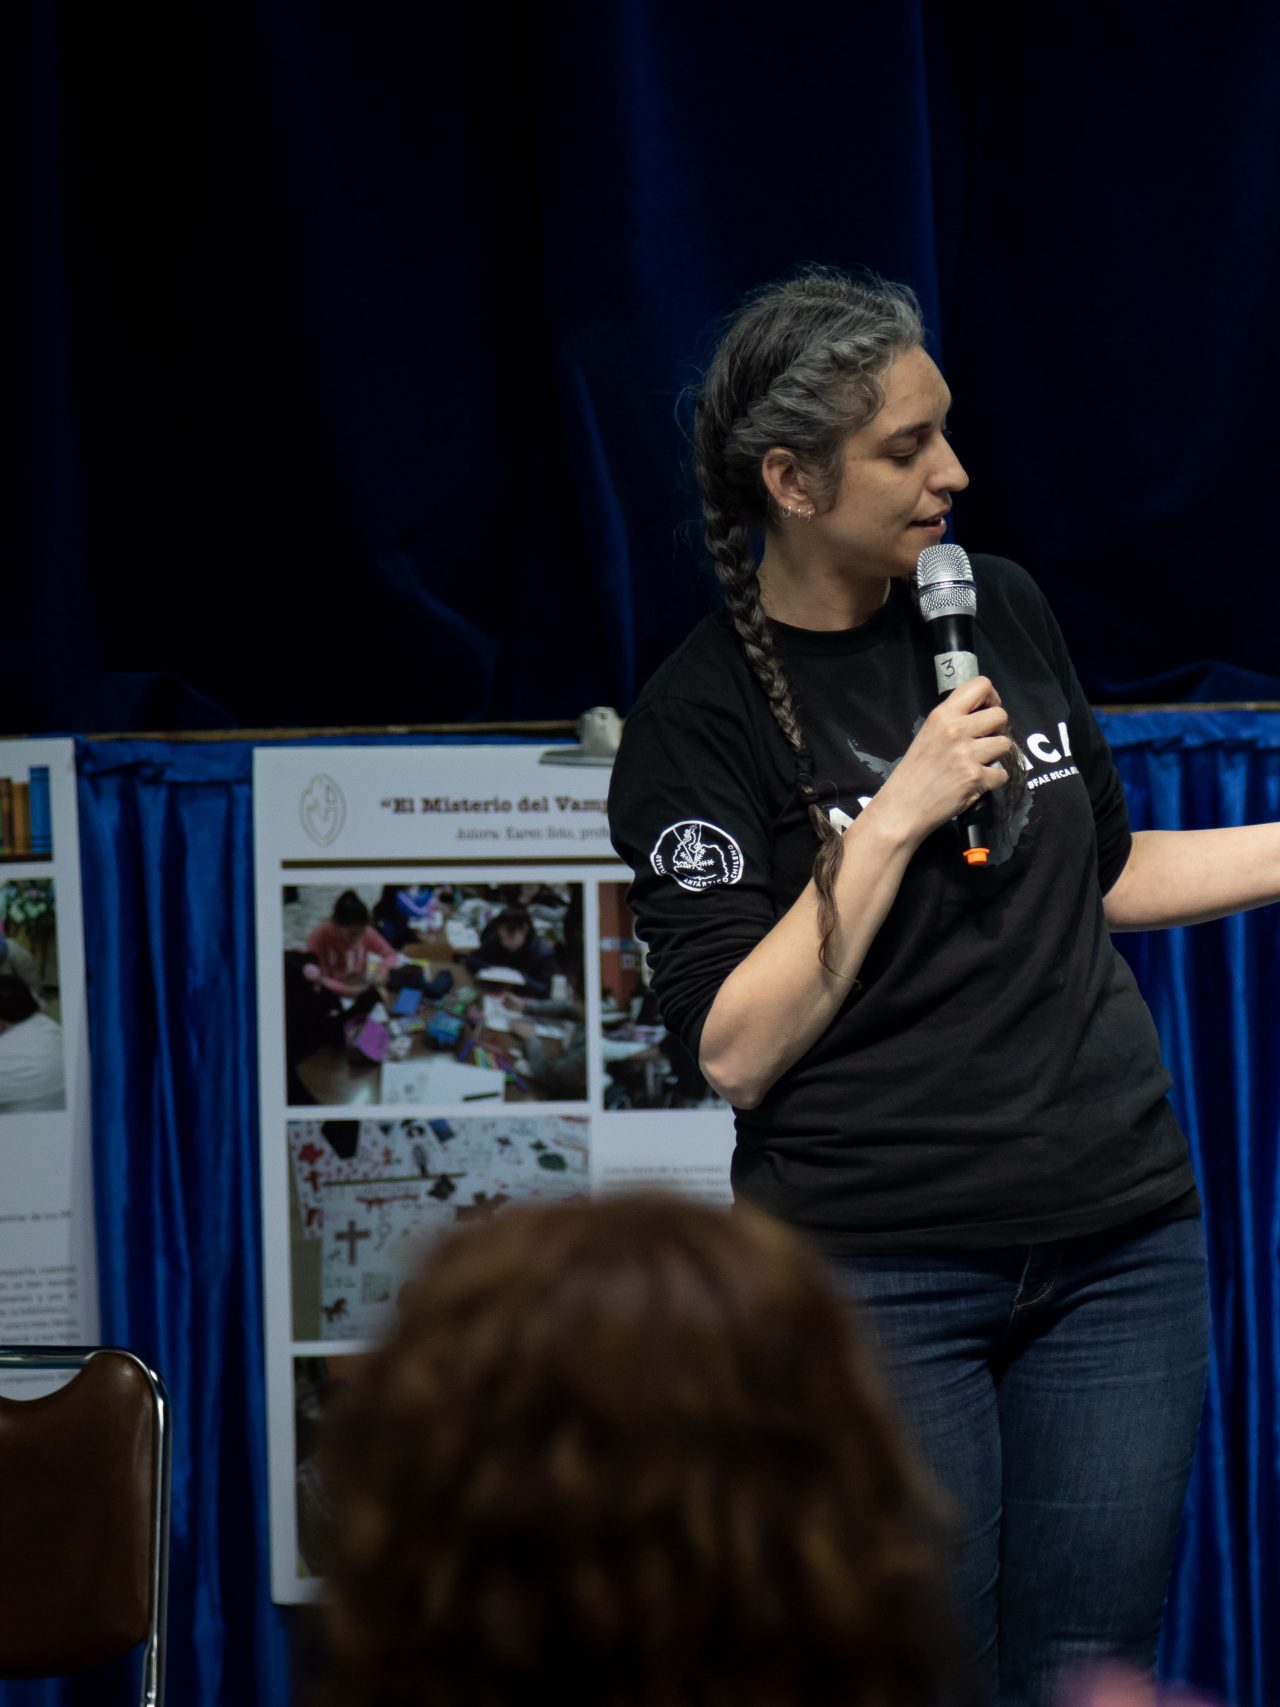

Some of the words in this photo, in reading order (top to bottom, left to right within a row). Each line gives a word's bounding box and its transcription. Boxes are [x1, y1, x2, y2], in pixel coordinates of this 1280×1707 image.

[940, 658, 956, 678] 3
[421, 795, 513, 815] Misterio
[518, 796, 549, 814] del
